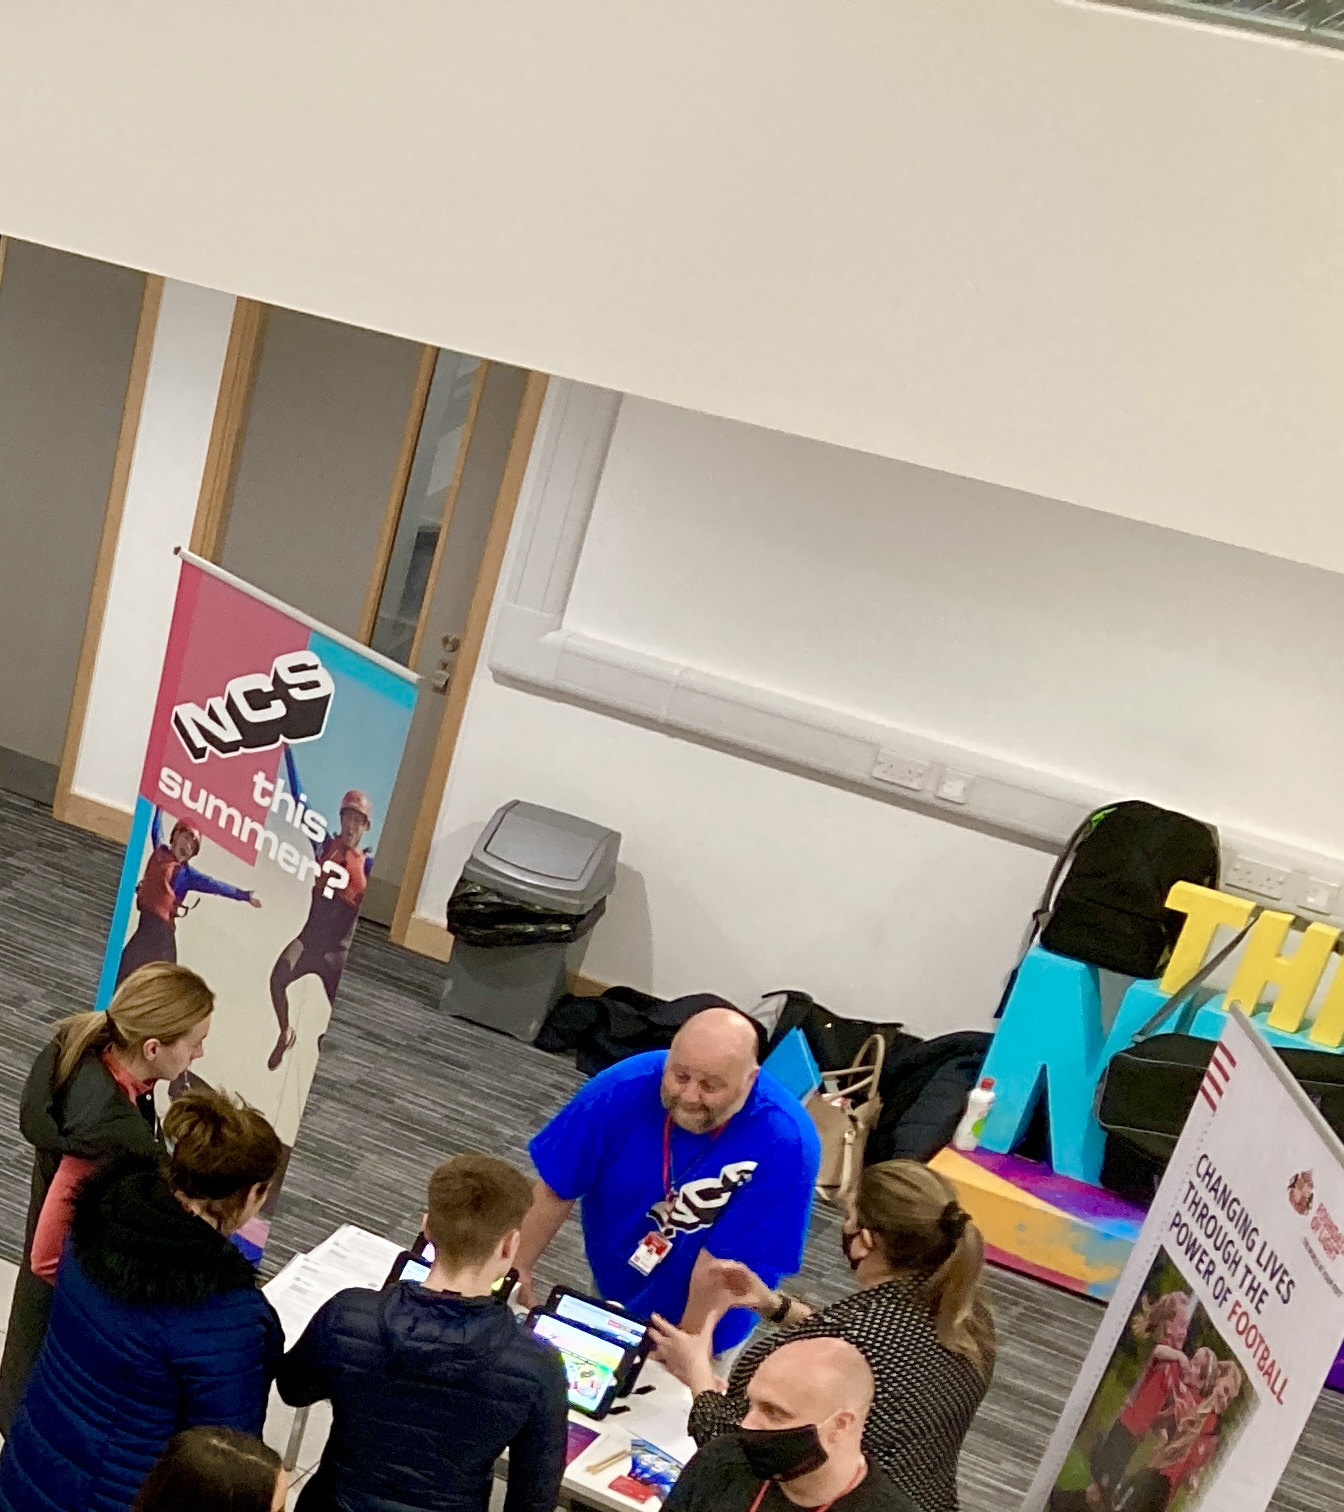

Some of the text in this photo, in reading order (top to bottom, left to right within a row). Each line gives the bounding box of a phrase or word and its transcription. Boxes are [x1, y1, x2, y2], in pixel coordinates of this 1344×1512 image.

[171, 650, 335, 764] NCS
[158, 766, 350, 900] summer?
[252, 770, 330, 844] this
[1182, 1180, 1270, 1316] THROUGH THE
[1195, 1153, 1296, 1305] CHANGING LIVES
[1168, 1210, 1289, 1406] POWER OF FOOTBALL
